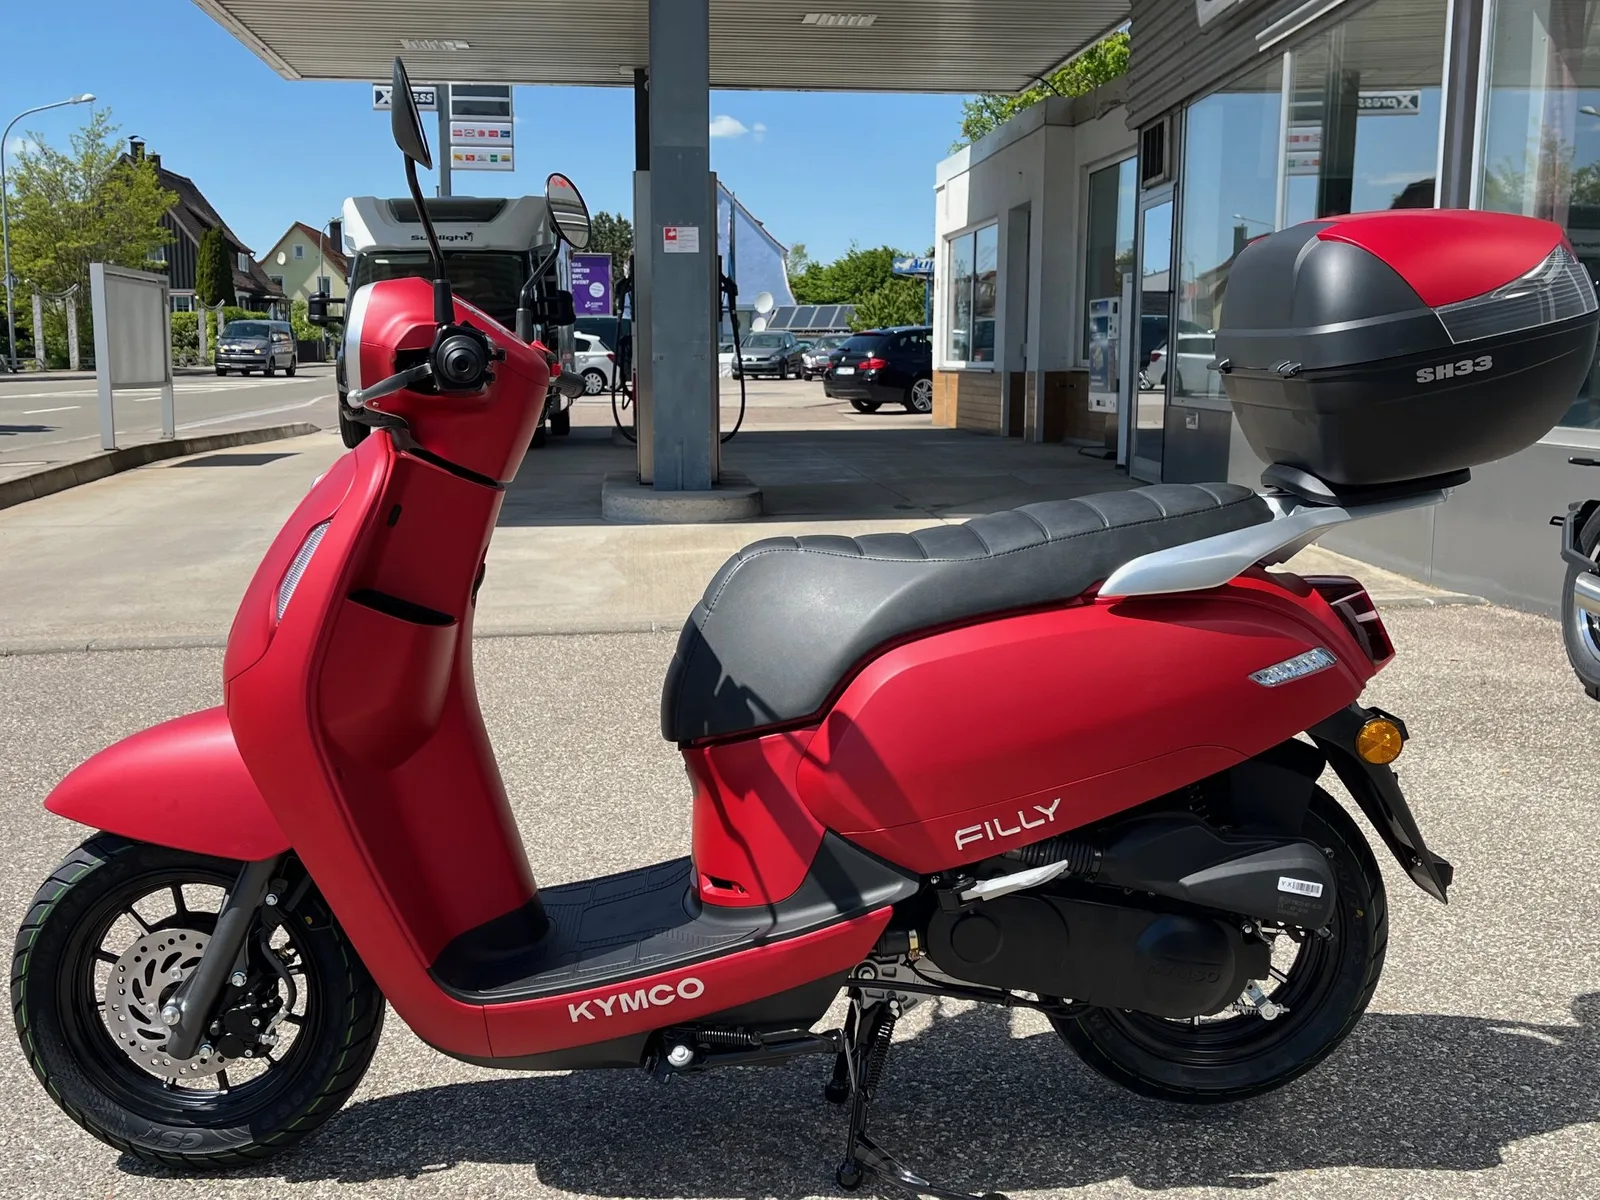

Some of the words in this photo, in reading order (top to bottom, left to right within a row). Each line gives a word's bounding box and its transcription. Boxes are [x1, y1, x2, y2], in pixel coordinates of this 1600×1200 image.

[410, 234, 470, 242] Sulight
[1416, 355, 1493, 384] SH33
[954, 798, 1061, 851] FILLY
[567, 977, 705, 1023] KYMCO
